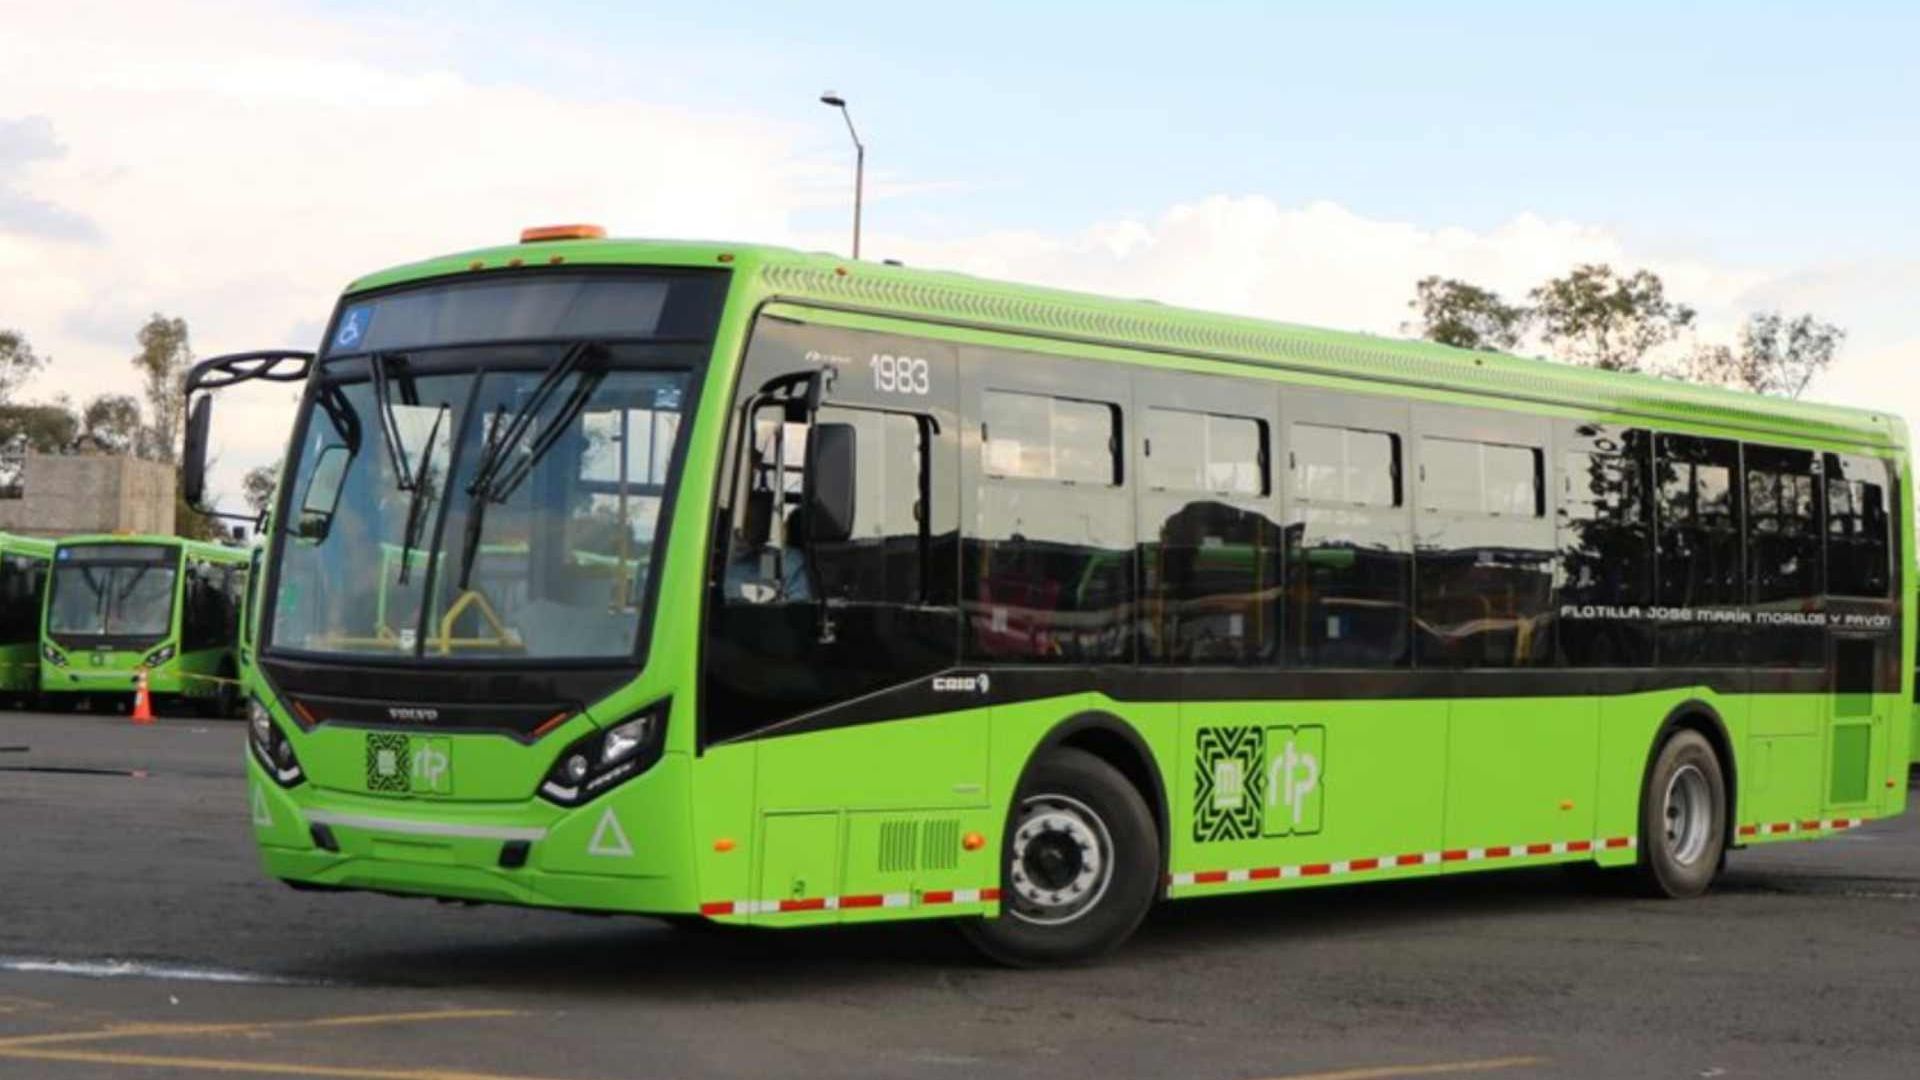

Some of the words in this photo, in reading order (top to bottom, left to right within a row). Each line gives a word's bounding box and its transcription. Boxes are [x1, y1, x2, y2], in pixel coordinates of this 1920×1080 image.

[870, 353, 929, 395] 1983
[1560, 605, 1641, 619] FLOTILLA
[1757, 611, 1826, 625] MORELOS
[1831, 614, 1841, 623] Y
[389, 708, 438, 719] VOLVO
